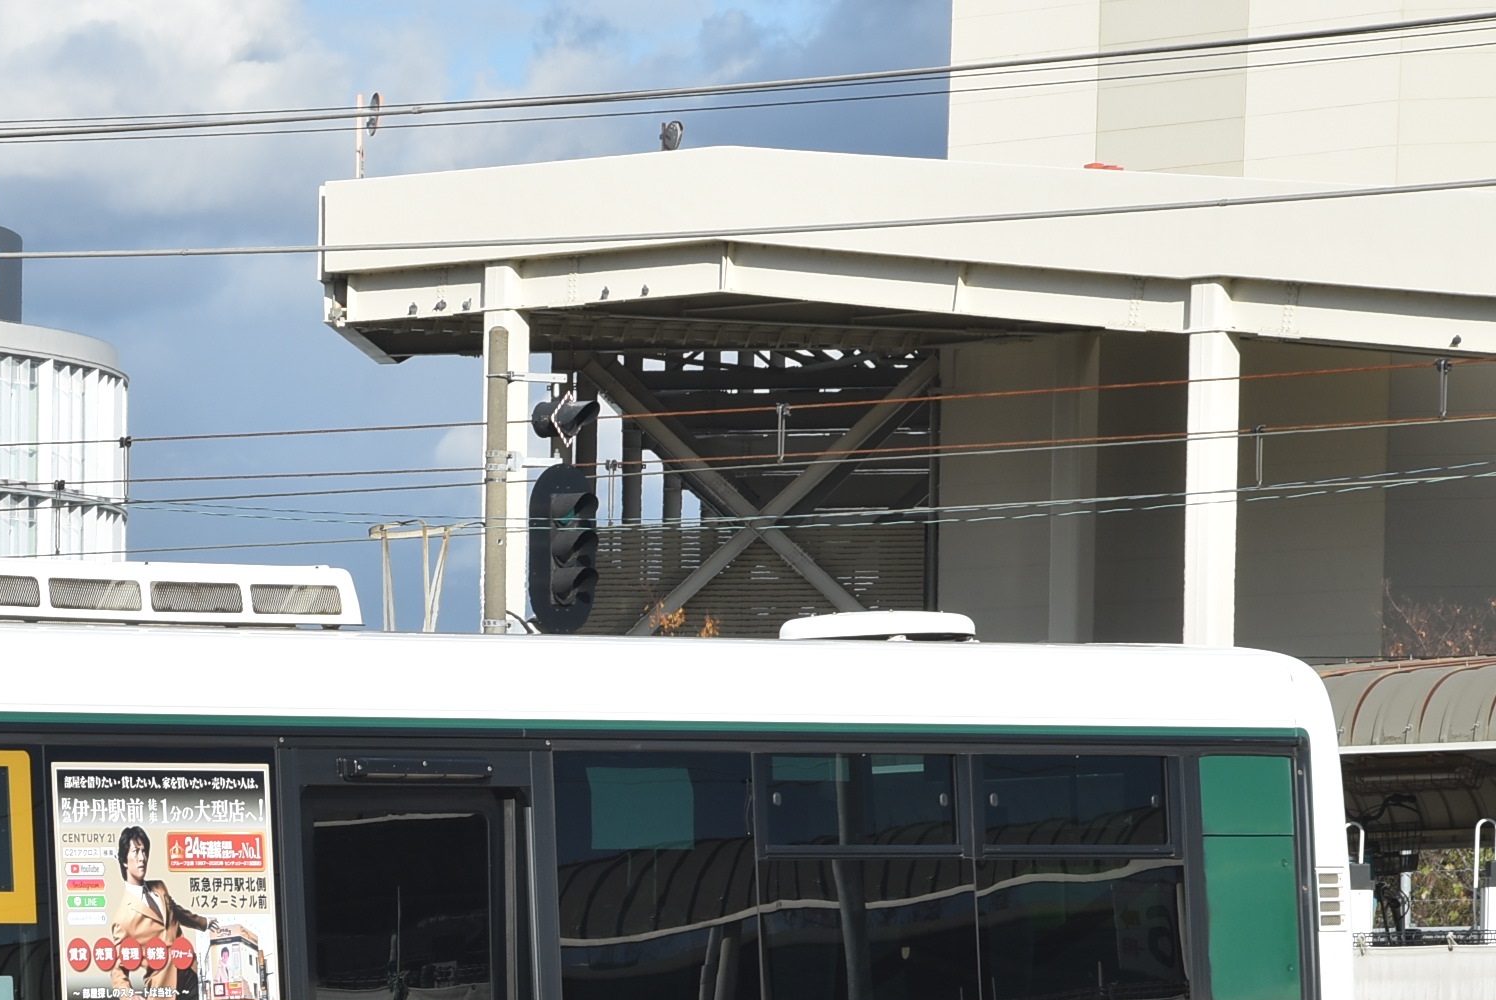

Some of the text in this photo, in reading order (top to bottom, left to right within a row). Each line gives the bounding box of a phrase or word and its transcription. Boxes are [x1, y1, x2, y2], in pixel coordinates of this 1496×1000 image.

[62, 833, 116, 843] CENTURY 21
[80, 864, 100, 873] YouTube
[190, 877, 266, 892] 阪急伊丹駅北側
[84, 898, 98, 906] LINE
[191, 895, 267, 909] バスターミナル前
[68, 948, 88, 960] 賃貸
[96, 948, 114, 960] 売買
[122, 947, 140, 960] 管理
[146, 947, 166, 960] 新築
[171, 949, 194, 959] リフォーム
